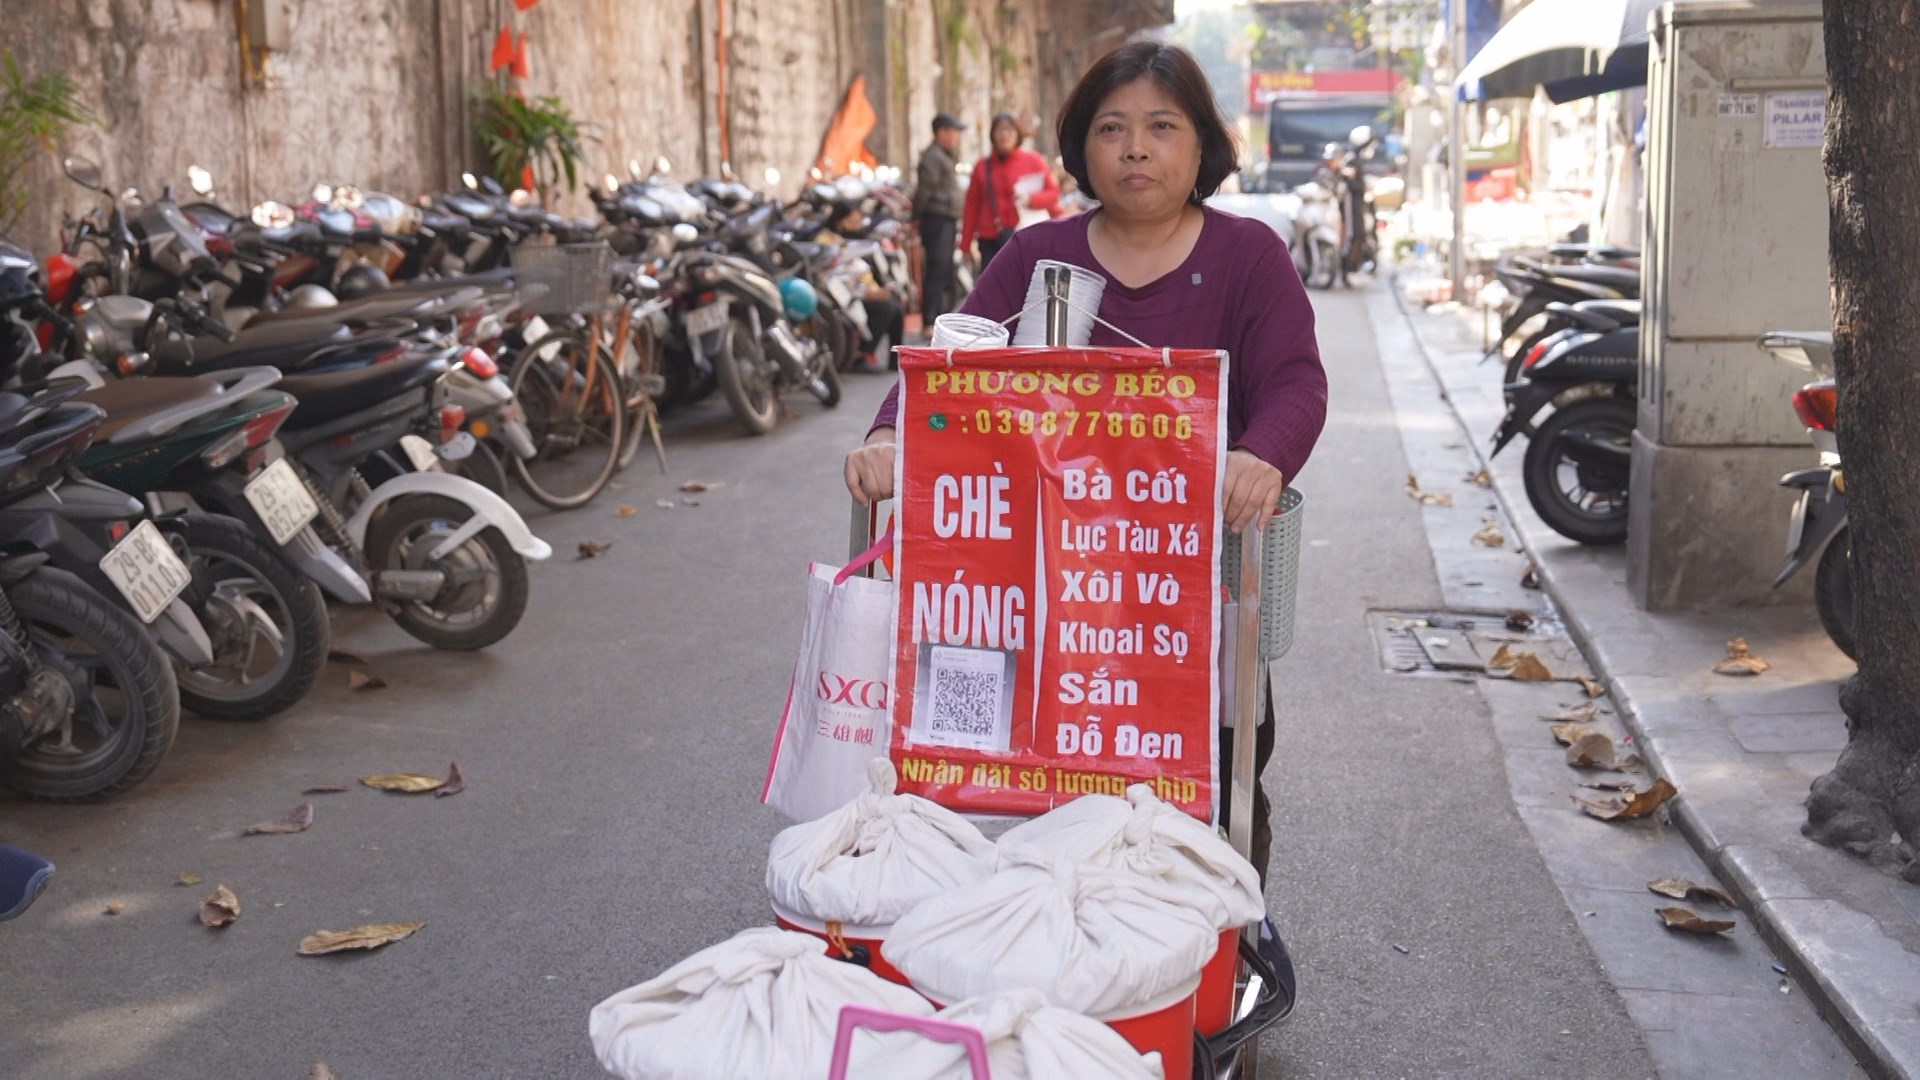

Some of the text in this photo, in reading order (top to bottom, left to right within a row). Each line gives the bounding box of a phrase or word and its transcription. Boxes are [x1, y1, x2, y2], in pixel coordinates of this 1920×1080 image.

[1773, 113, 1821, 124] PILLAR
[926, 368, 1196, 398] PHƯƠNG BÉO
[933, 462, 1012, 540] CHÈ
[1062, 467, 1188, 504] Bà Cốt
[1061, 518, 1199, 558] Lục Tàu Xá
[1059, 569, 1180, 605] Xôi Vò
[911, 569, 1025, 650] NÓNG
[1059, 621, 1189, 663] Khoai Sọ
[1058, 667, 1138, 706] Sắn
[1056, 715, 1183, 759] Đỗ Đen
[902, 757, 963, 785] Nhận
[973, 763, 1012, 791] đặt
[1020, 765, 1047, 792] số
[1146, 779, 1196, 803] hip
